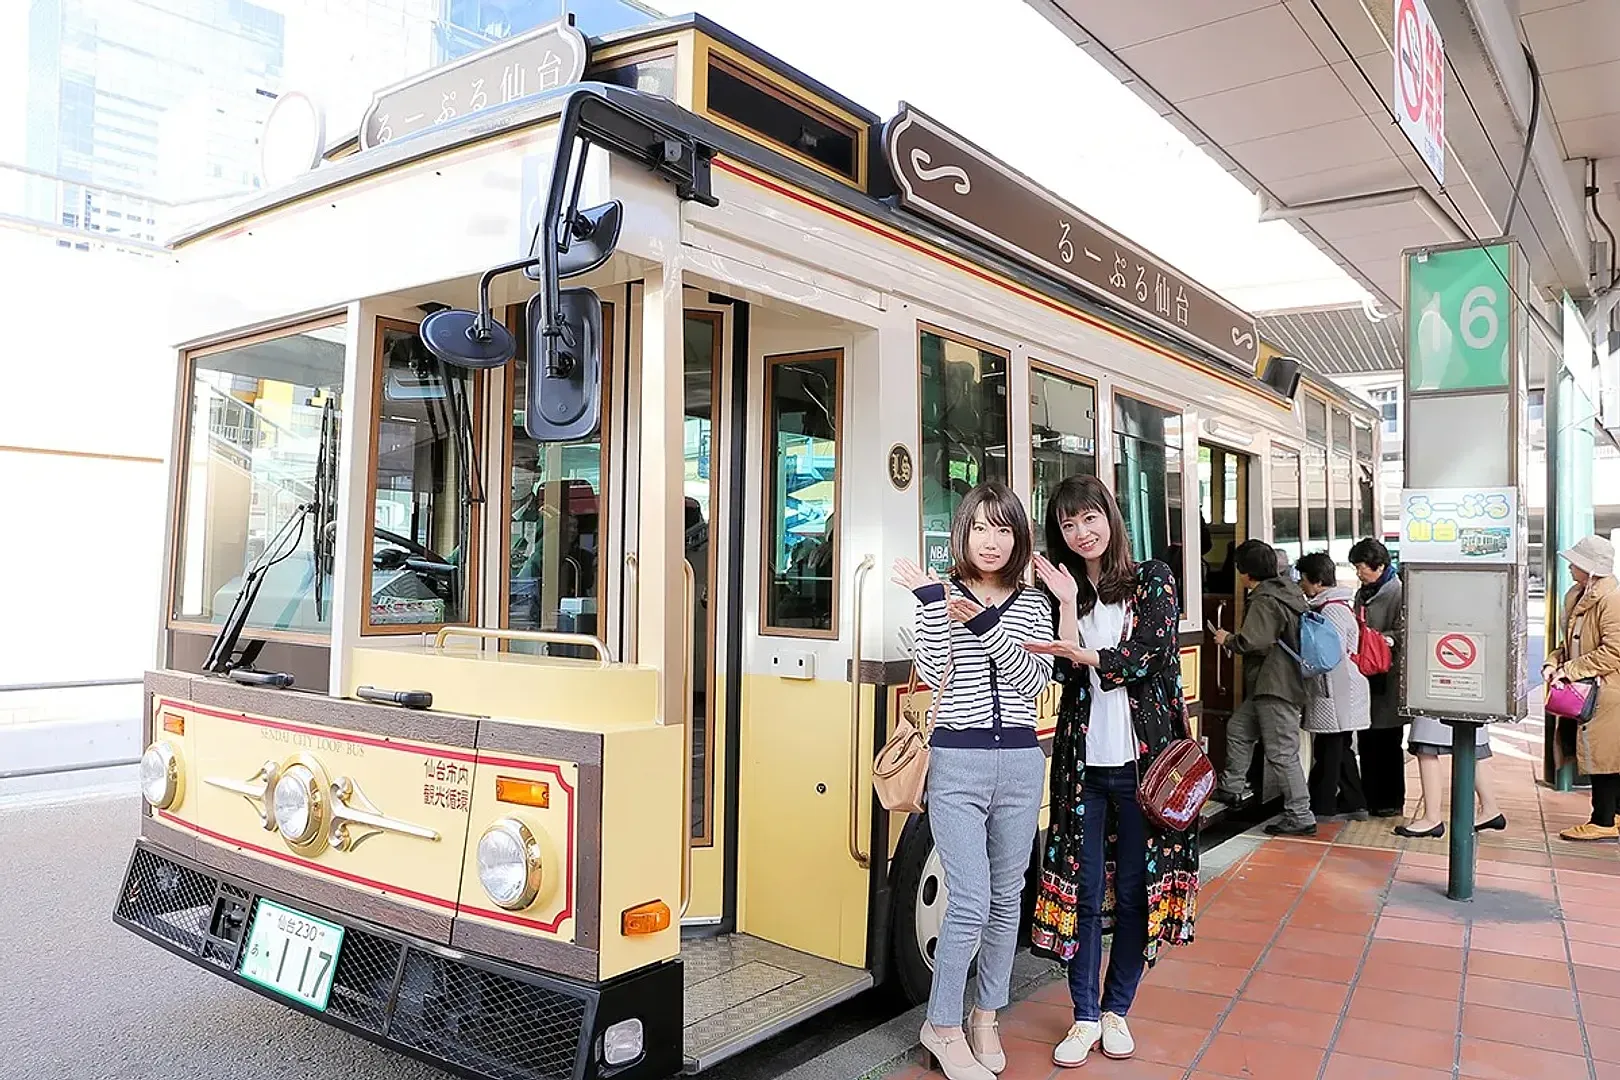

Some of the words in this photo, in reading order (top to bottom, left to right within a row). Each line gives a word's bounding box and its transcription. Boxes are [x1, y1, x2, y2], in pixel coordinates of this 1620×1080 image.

[377, 50, 562, 146] るーぷる仙台
[1058, 219, 1190, 326] るーぷる仙台
[1407, 493, 1510, 520] るーぷる
[1406, 518, 1457, 542] 仙台
[260, 728, 290, 743] SENDAI
[293, 733, 313, 748] CITY
[317, 738, 342, 753] LOOP
[346, 742, 365, 757] BUS
[424, 758, 468, 785] 仙台市内
[423, 784, 468, 812] 観光循環
